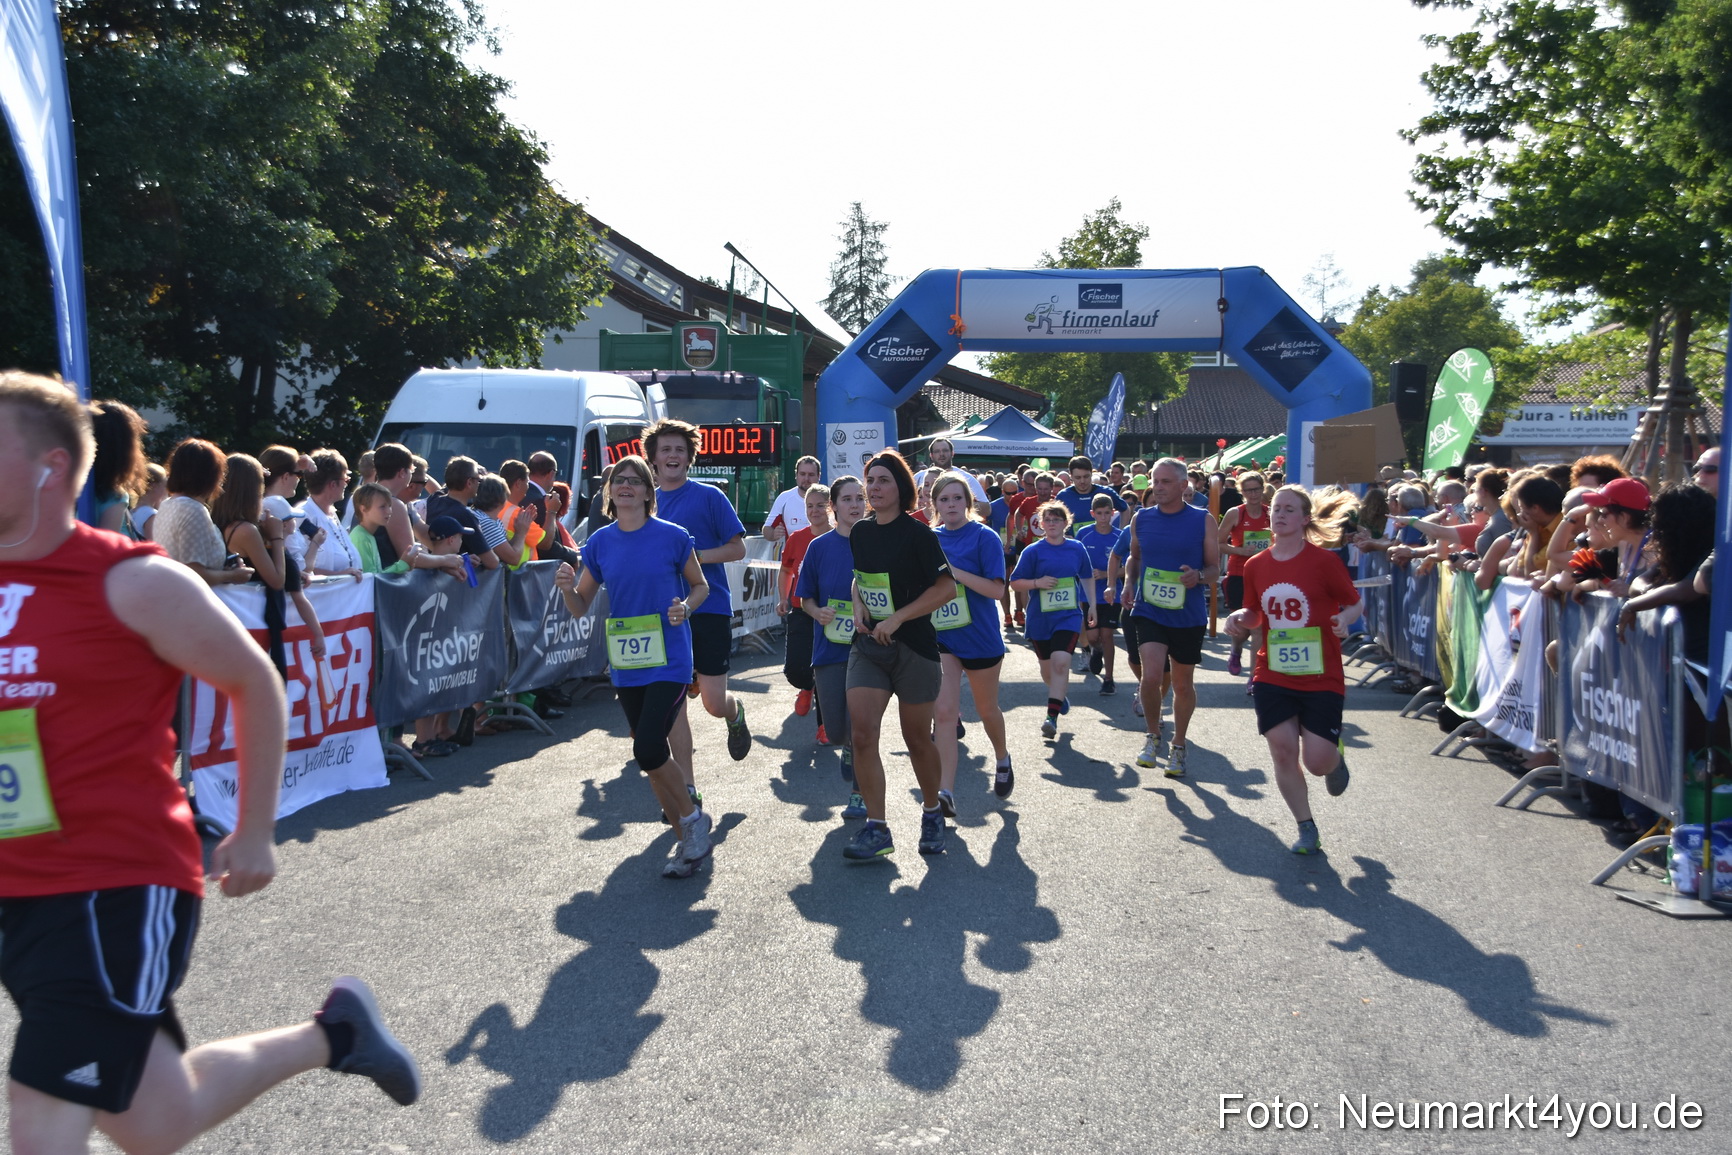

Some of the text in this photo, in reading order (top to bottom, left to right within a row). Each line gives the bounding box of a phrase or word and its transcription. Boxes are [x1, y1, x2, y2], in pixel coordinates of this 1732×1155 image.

[1087, 292, 1120, 300] Fischer
[1062, 309, 1160, 328] firmenlauf
[878, 345, 930, 356] Fischer
[1457, 392, 1484, 425] AOK
[1516, 410, 1554, 422] Jura
[1428, 415, 1459, 454] AOK
[967, 444, 1048, 452] www.fischer-automobile.de
[1046, 590, 1070, 603] 762
[1151, 583, 1177, 600] 755
[935, 602, 959, 619] 790
[835, 616, 854, 633] 79
[416, 626, 485, 672] Fischer
[617, 636, 651, 655] 797
[1278, 646, 1309, 663] 551
[428, 668, 478, 695] AUTOMOBILE
[1580, 671, 1641, 736] Fischer
